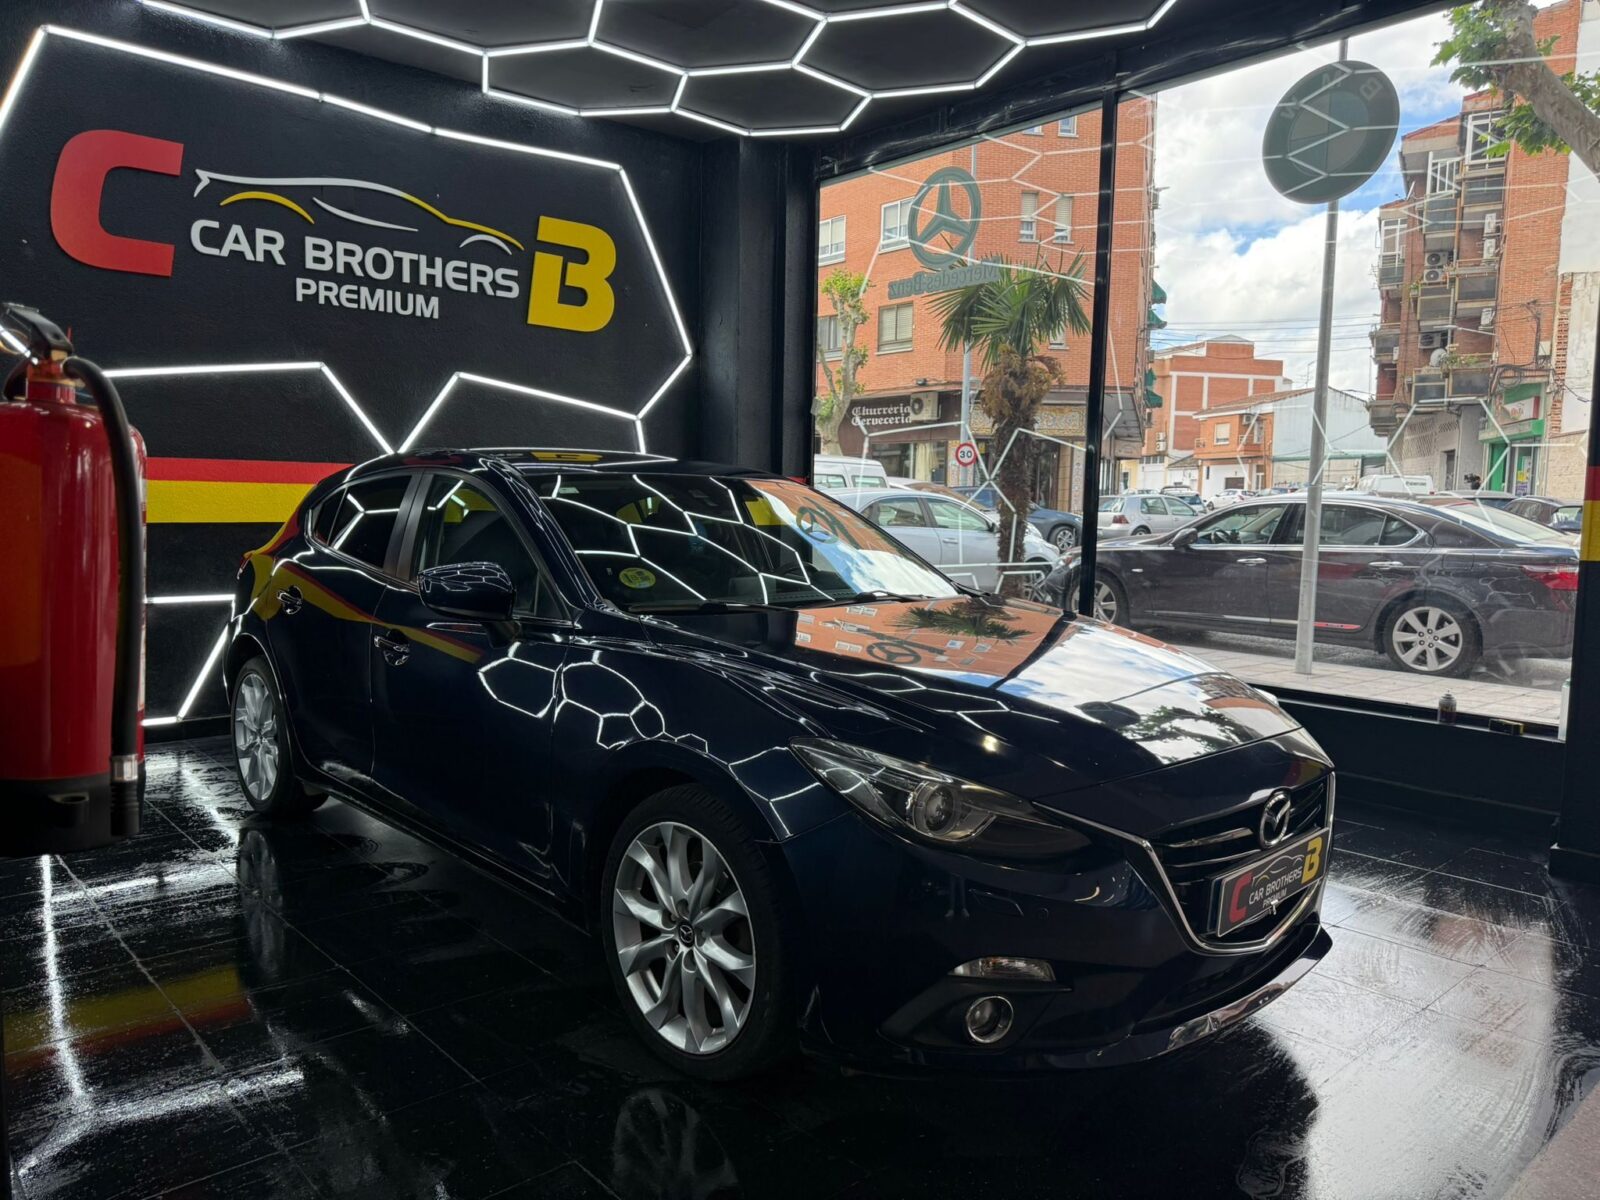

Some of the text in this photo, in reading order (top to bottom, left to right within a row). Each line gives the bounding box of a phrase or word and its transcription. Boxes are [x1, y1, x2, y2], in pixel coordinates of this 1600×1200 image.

[50, 129, 184, 277] C
[190, 219, 520, 299] CAR BROTHERS
[527, 215, 616, 332] B
[295, 277, 439, 319] PREMIUM
[1249, 866, 1303, 905] CAR BROTHERS
[1301, 836, 1323, 884] B
[1229, 871, 1253, 923] C
